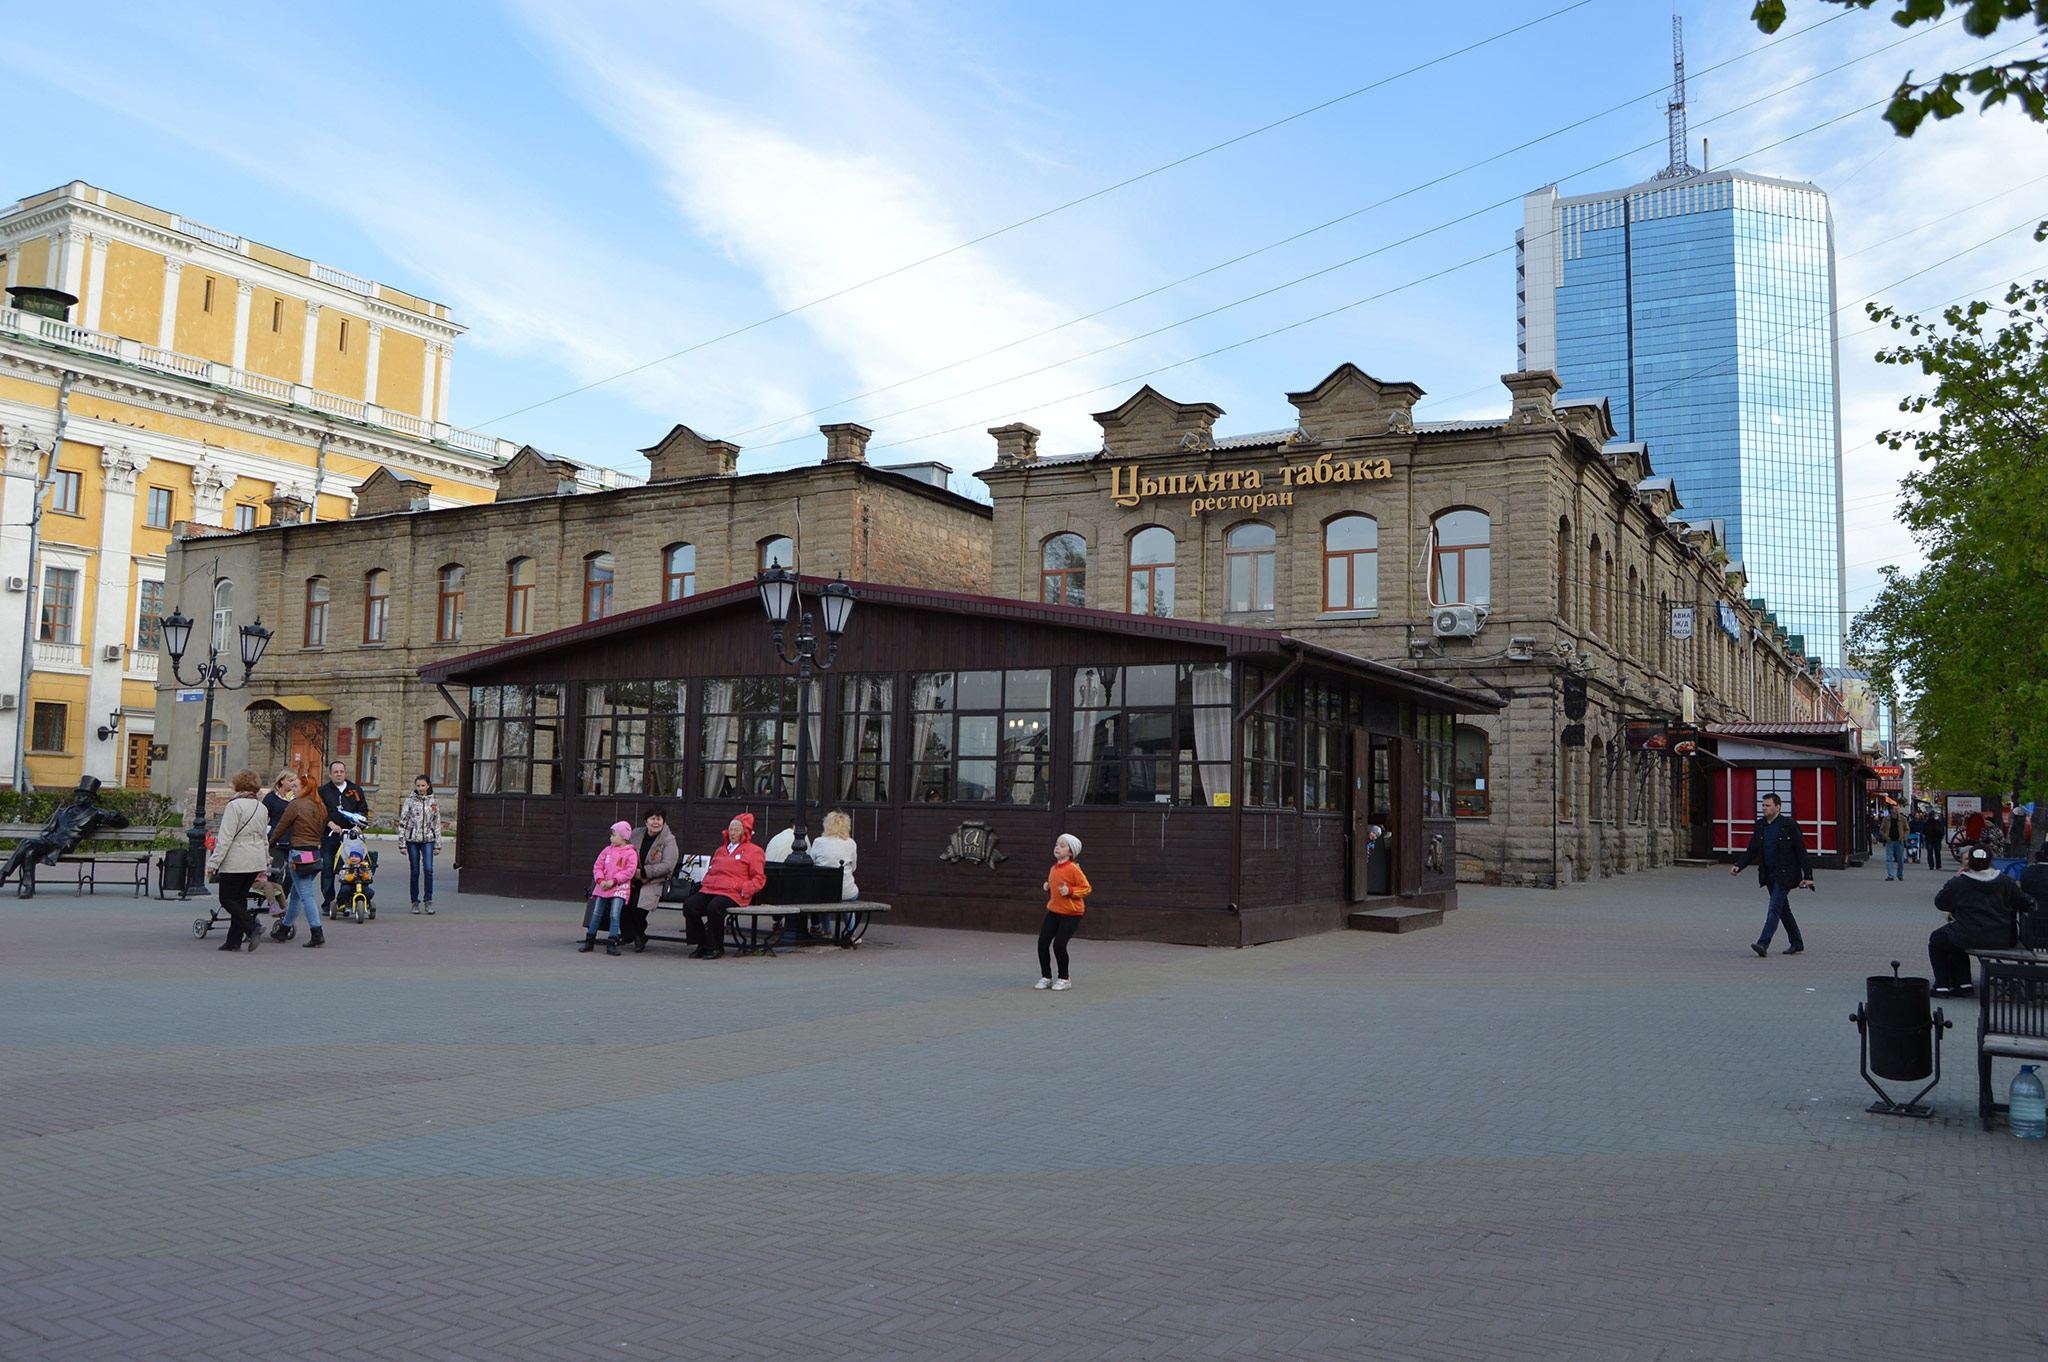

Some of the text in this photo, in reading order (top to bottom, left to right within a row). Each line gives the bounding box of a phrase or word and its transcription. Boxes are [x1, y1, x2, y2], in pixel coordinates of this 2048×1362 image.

[1110, 453, 1393, 507] Цыплята табака
[1191, 491, 1294, 517] ресторан
[1674, 620, 1689, 628] Ж/Д
